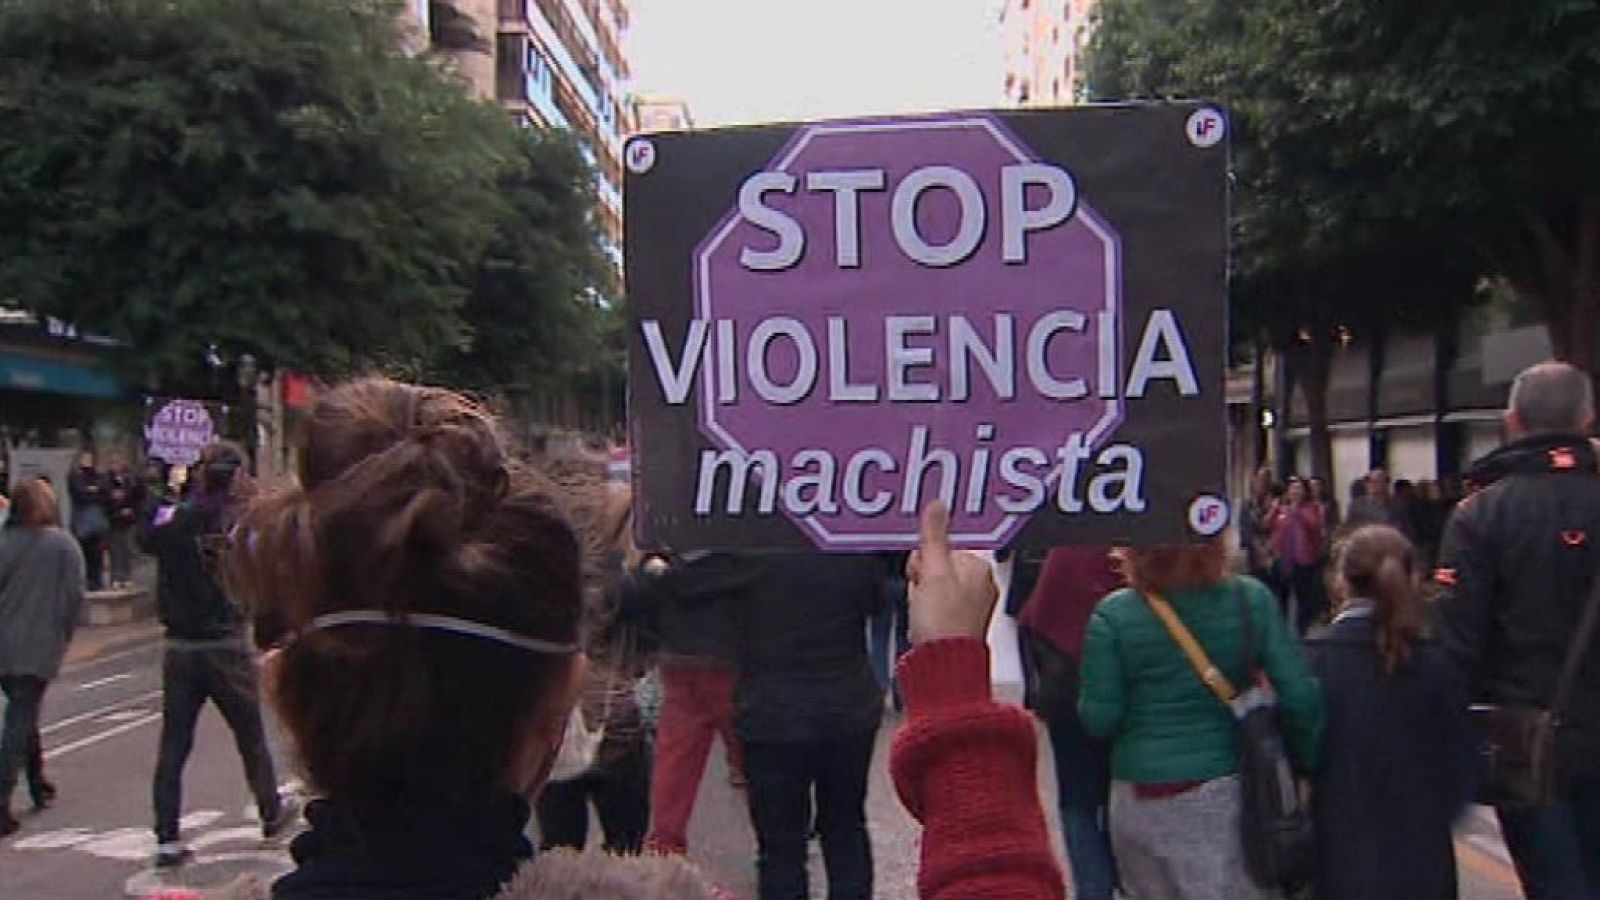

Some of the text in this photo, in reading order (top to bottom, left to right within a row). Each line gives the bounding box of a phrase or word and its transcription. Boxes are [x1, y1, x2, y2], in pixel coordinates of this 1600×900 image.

[737, 164, 1077, 270] STOP
[640, 309, 1198, 405] VIOLENCIA
[694, 424, 1145, 515] machista
